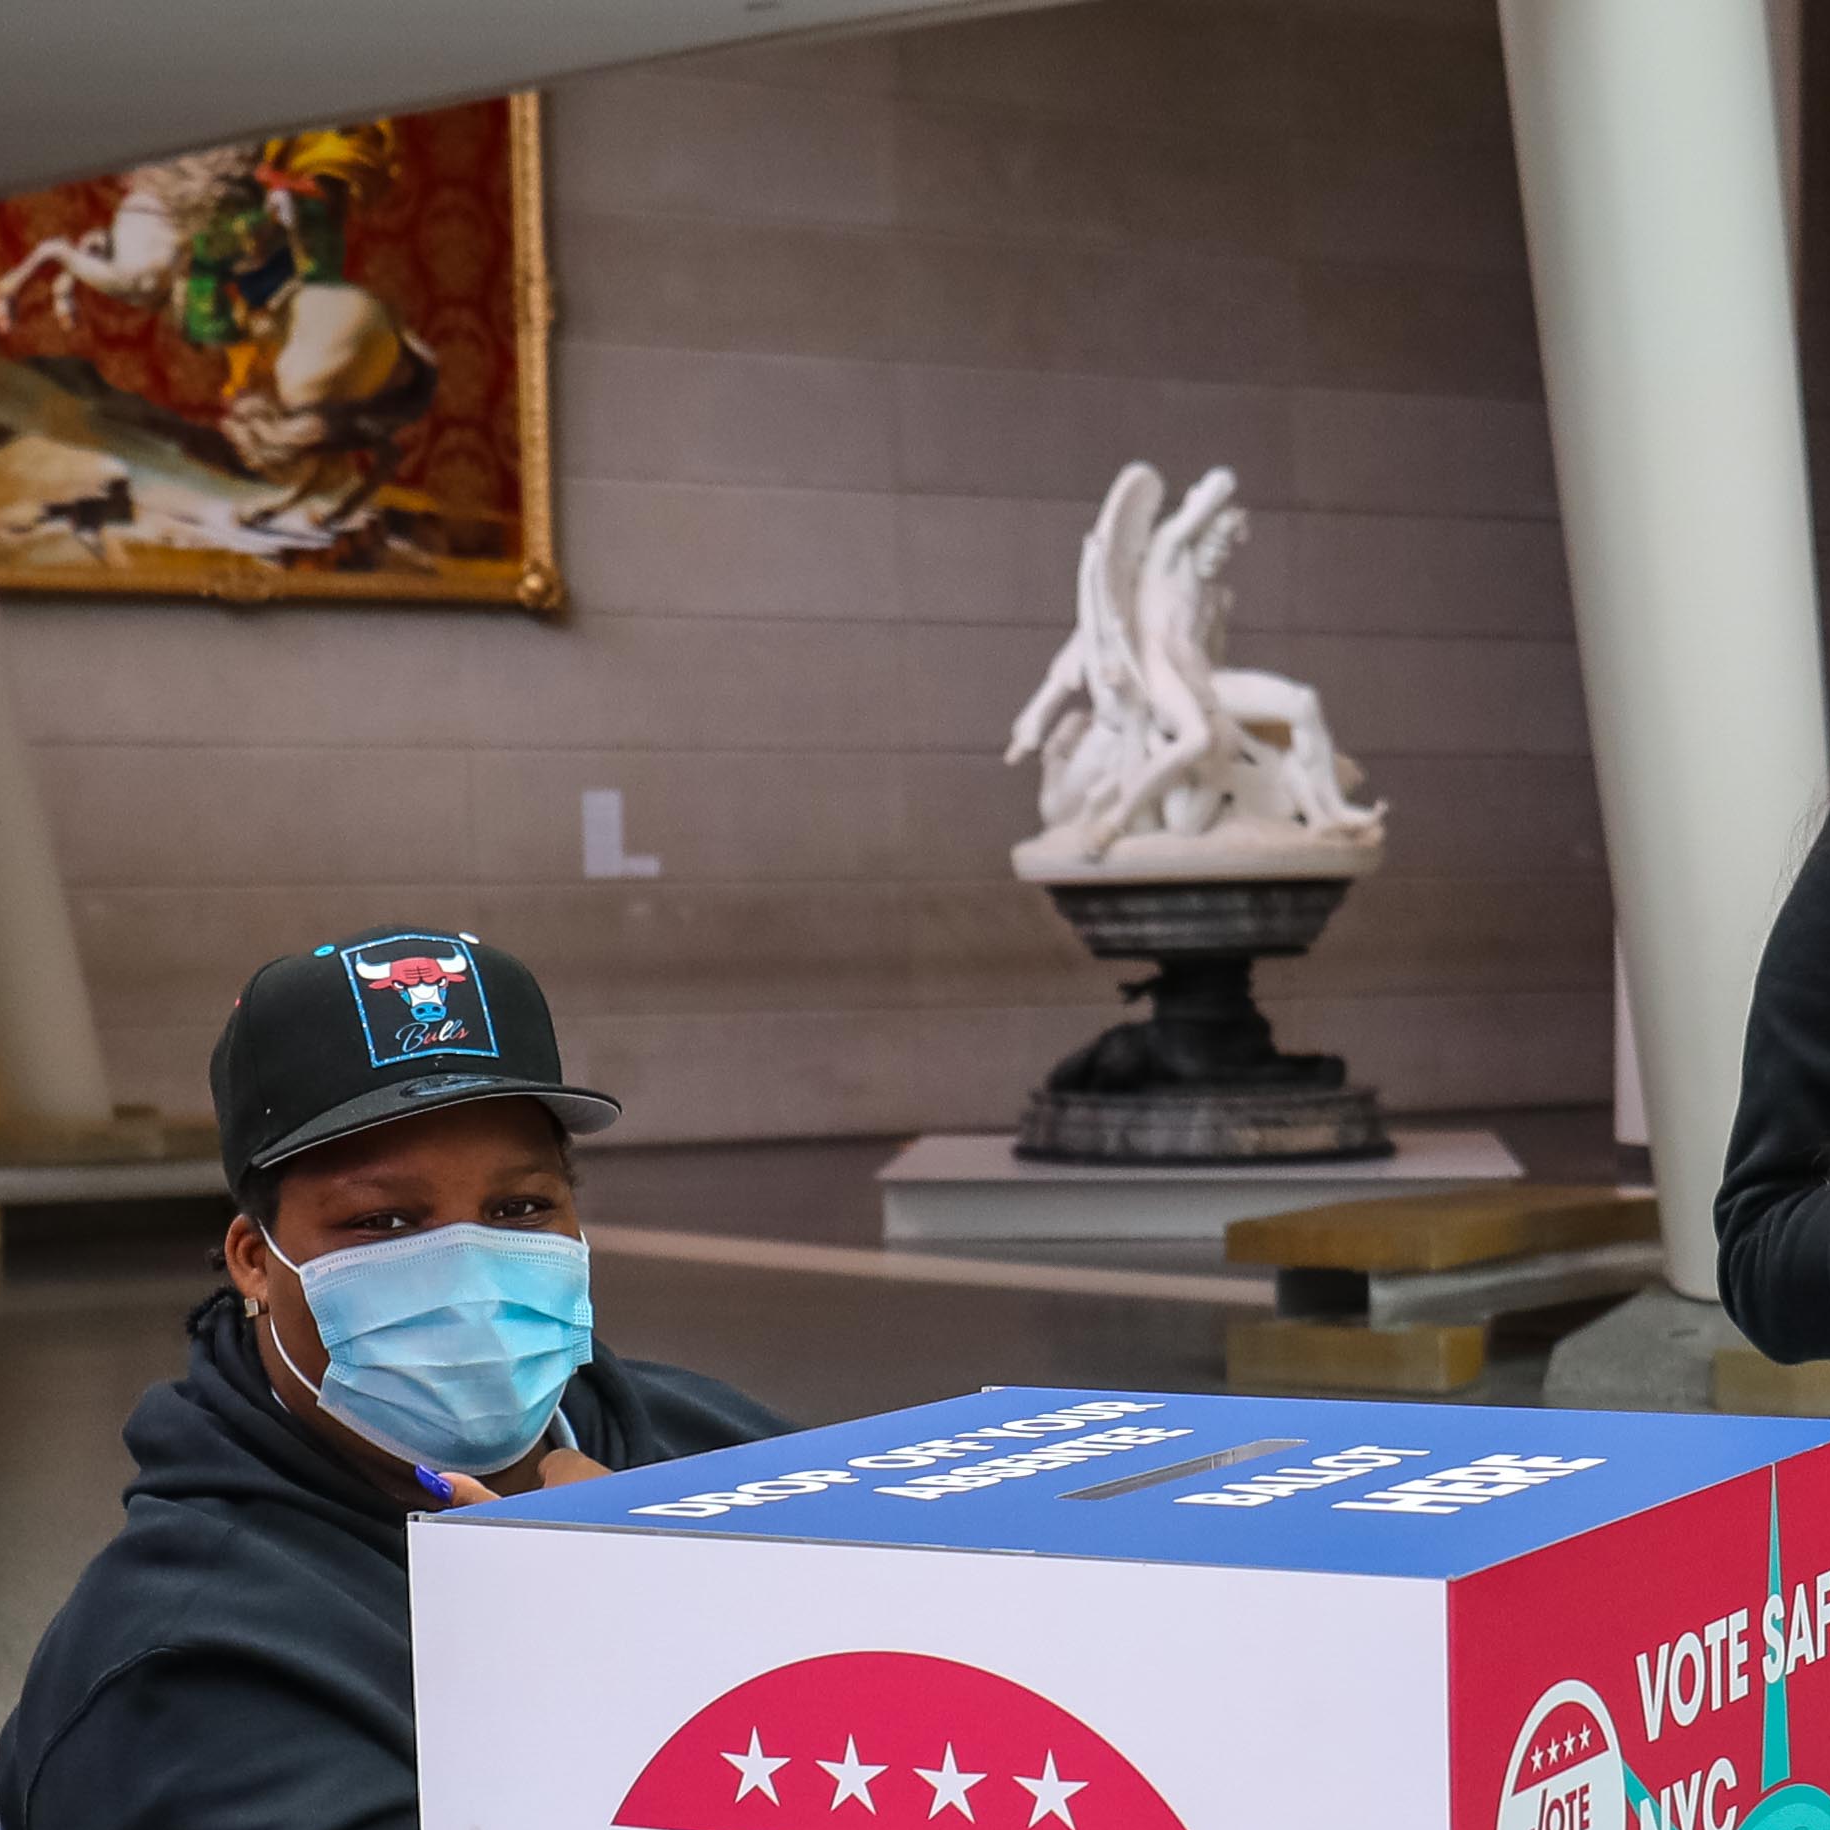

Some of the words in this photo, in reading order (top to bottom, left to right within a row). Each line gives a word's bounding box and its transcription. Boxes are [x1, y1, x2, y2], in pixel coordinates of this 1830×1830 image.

[395, 1019, 469, 1053] Bulls
[627, 1469, 860, 1518] DROP
[847, 1439, 995, 1469] OFF
[954, 1400, 1166, 1439] YOUR
[872, 1426, 1194, 1500] ABSENTEE
[1172, 1445, 1431, 1507] BALLOT
[1331, 1454, 1608, 1514] HERE
[1635, 1607, 1750, 1743] VOTE
